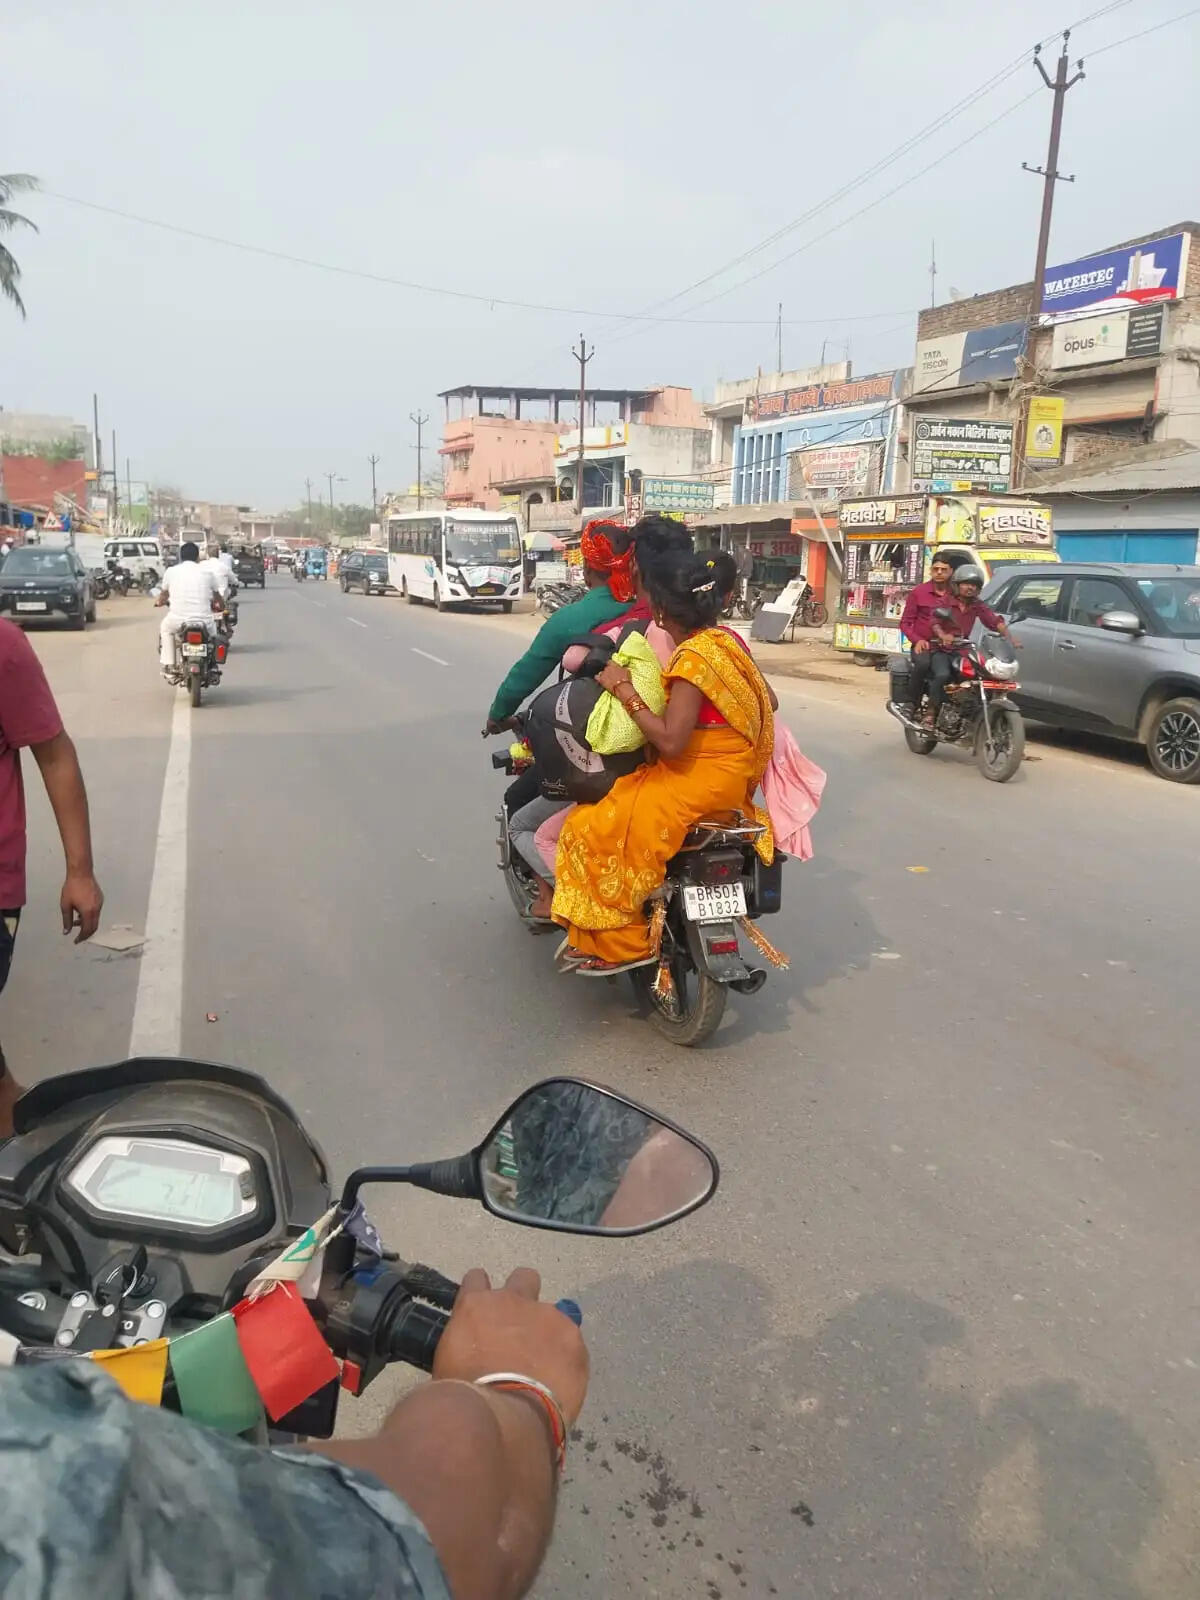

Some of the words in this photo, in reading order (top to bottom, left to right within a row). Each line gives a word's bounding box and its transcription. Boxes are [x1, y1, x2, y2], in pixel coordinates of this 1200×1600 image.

[1044, 267, 1115, 294] WATERTEC
[1064, 338, 1095, 353] opus
[923, 350, 941, 360] TATA
[922, 358, 949, 370] TISCON
[840, 501, 886, 523] महावीर
[698, 900, 740, 917] B1832
